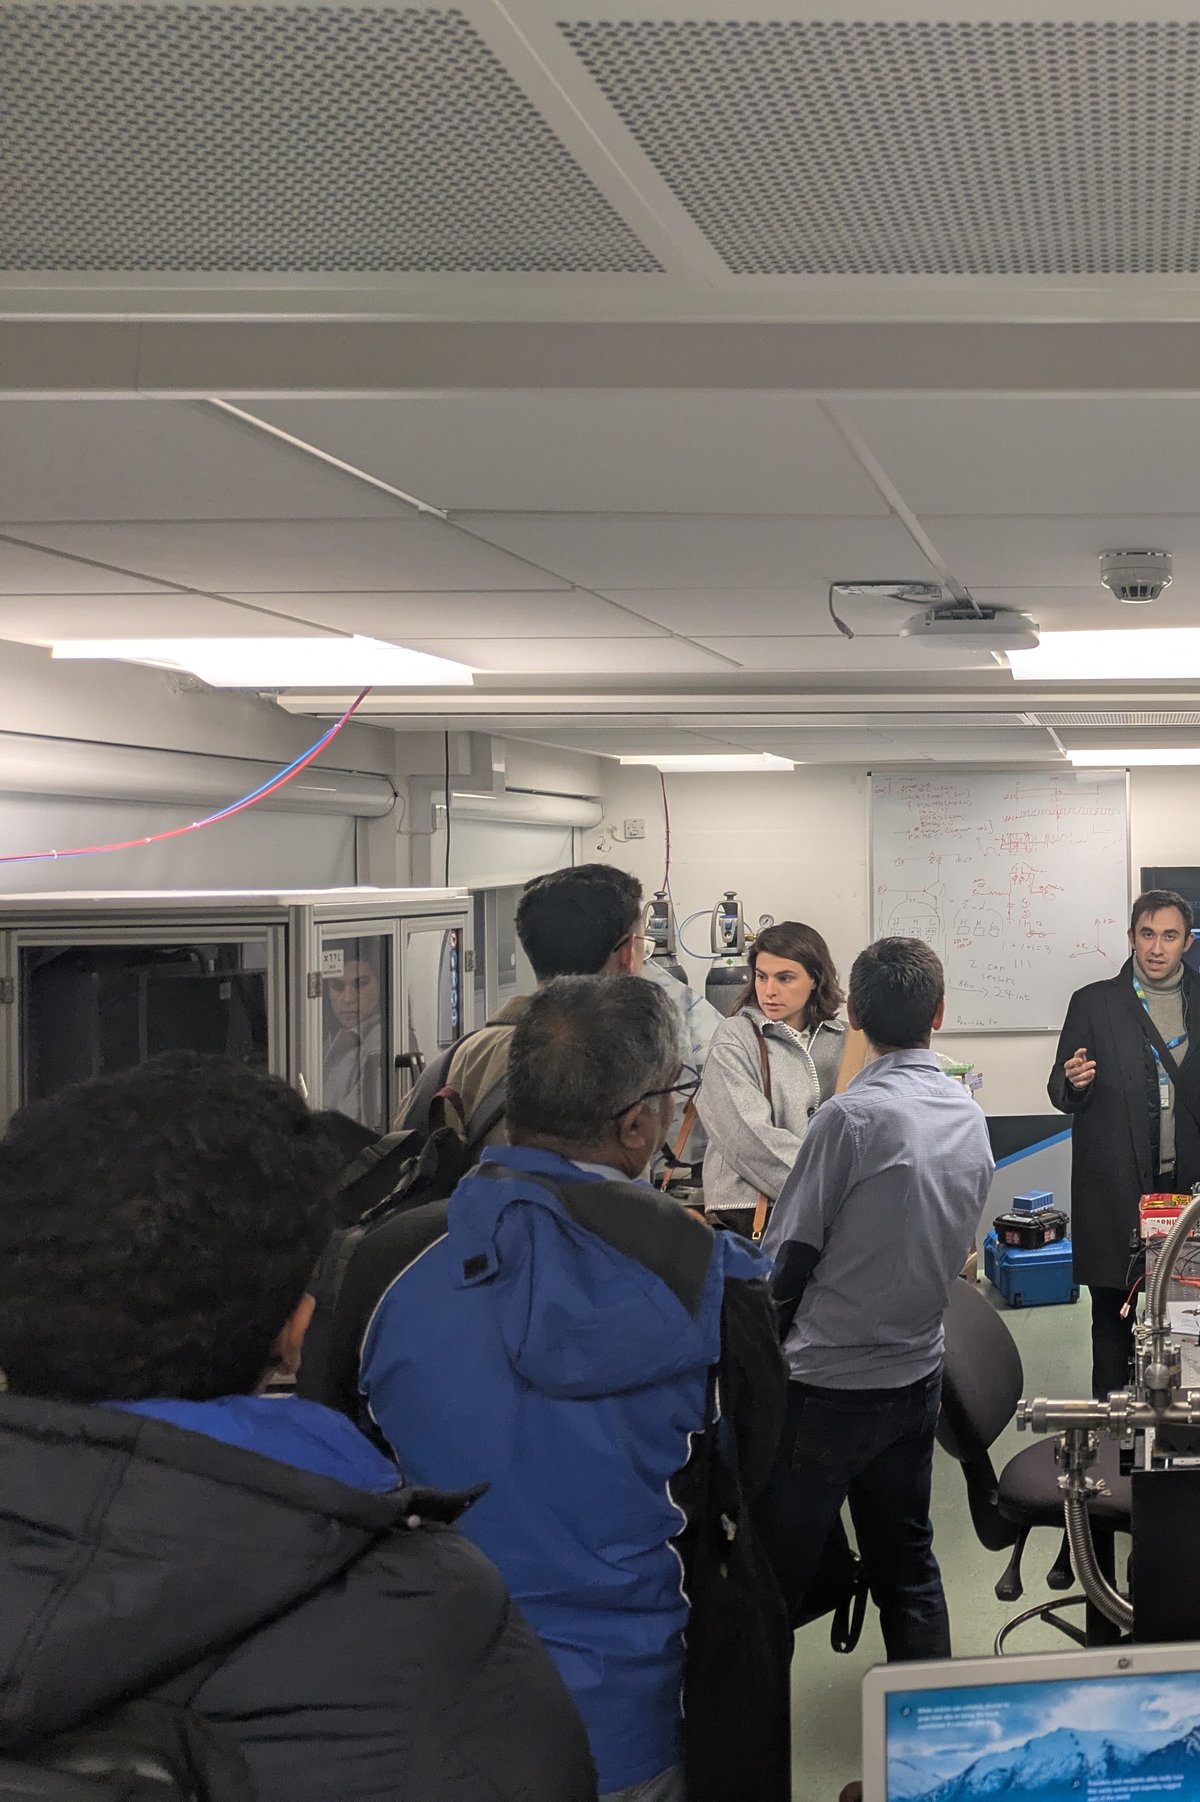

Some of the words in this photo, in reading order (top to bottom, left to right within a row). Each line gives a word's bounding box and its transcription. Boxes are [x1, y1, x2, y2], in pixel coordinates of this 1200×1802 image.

[961, 899, 986, 911] 2nd
[987, 963, 1005, 972] cap
[980, 972, 1016, 985] sensors
